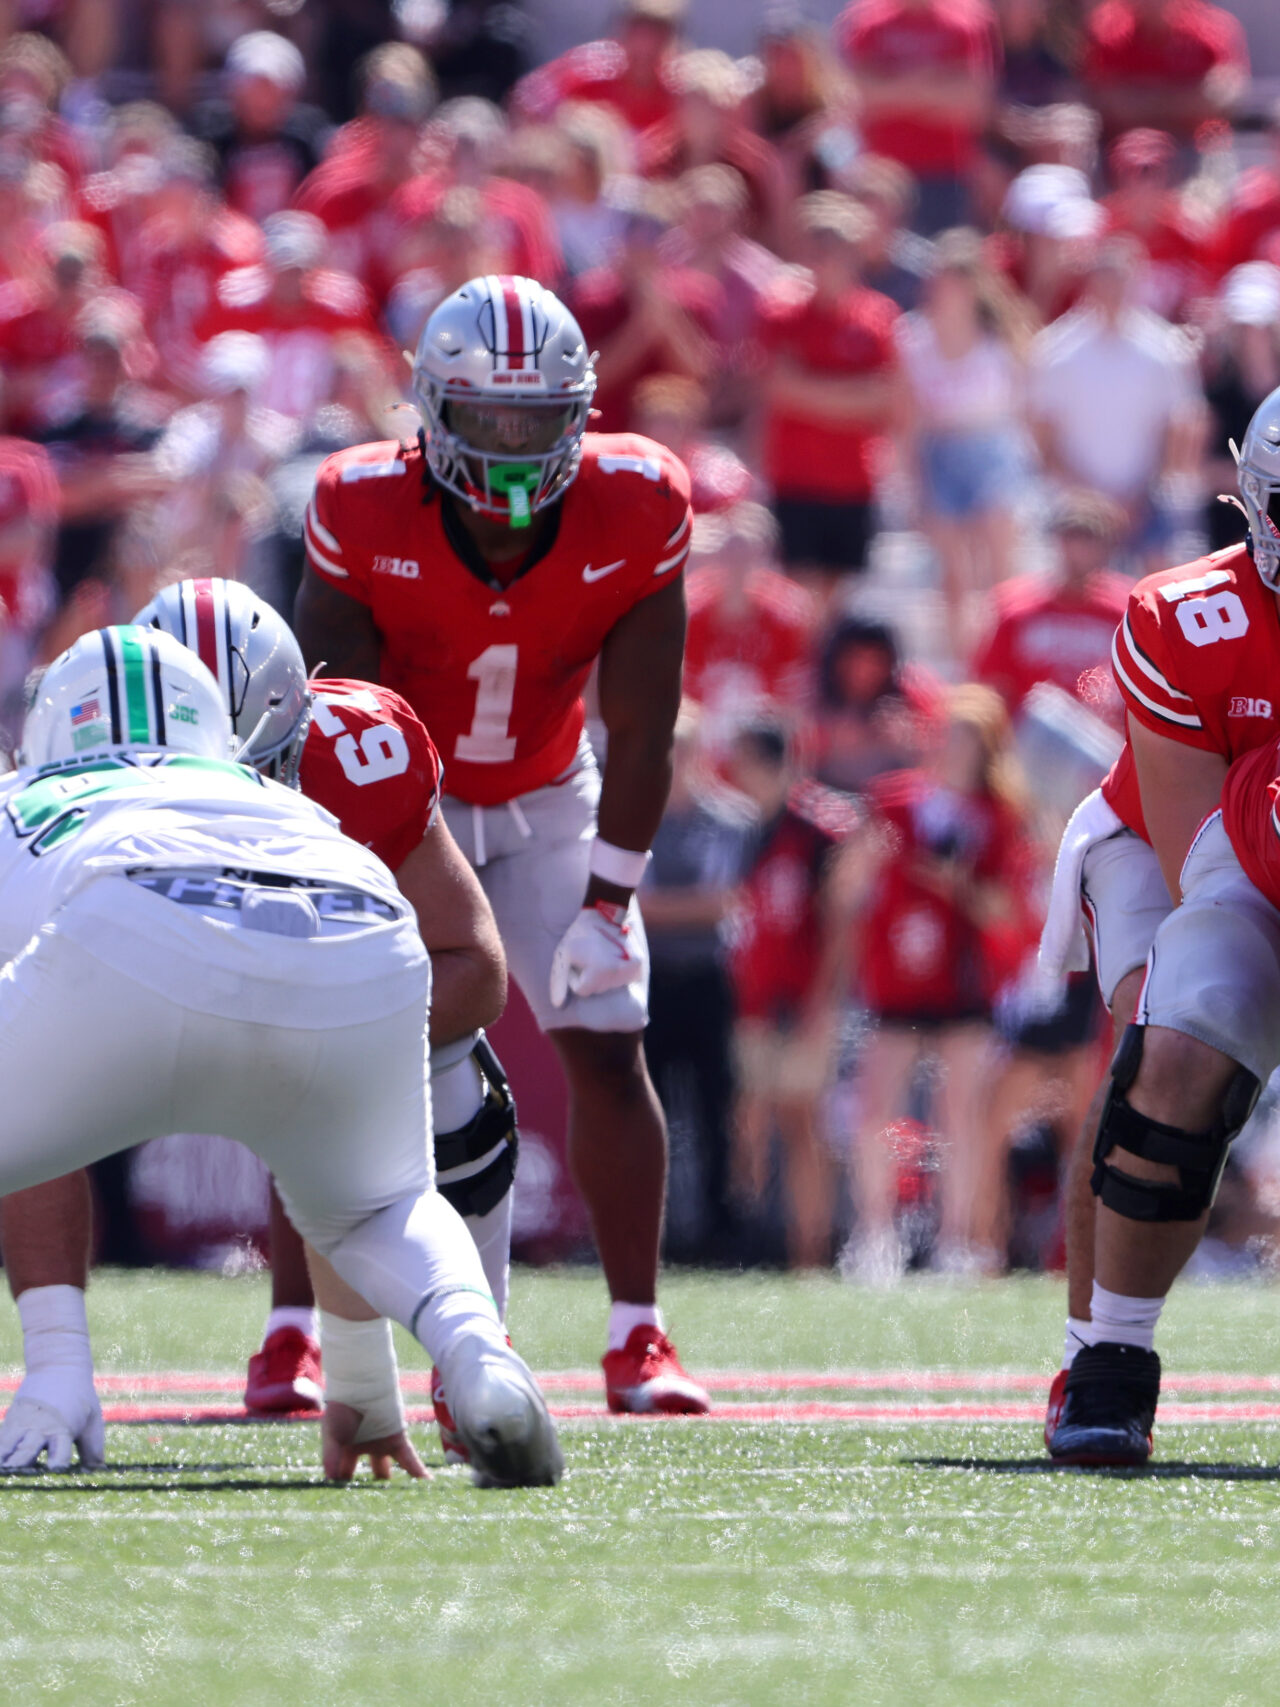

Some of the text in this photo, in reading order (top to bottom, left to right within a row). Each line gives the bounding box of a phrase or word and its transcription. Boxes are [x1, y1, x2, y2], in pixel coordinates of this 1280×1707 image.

[341, 458, 407, 484] 1
[597, 455, 661, 483] 1
[1157, 570, 1250, 648] 18
[454, 643, 518, 763] 1
